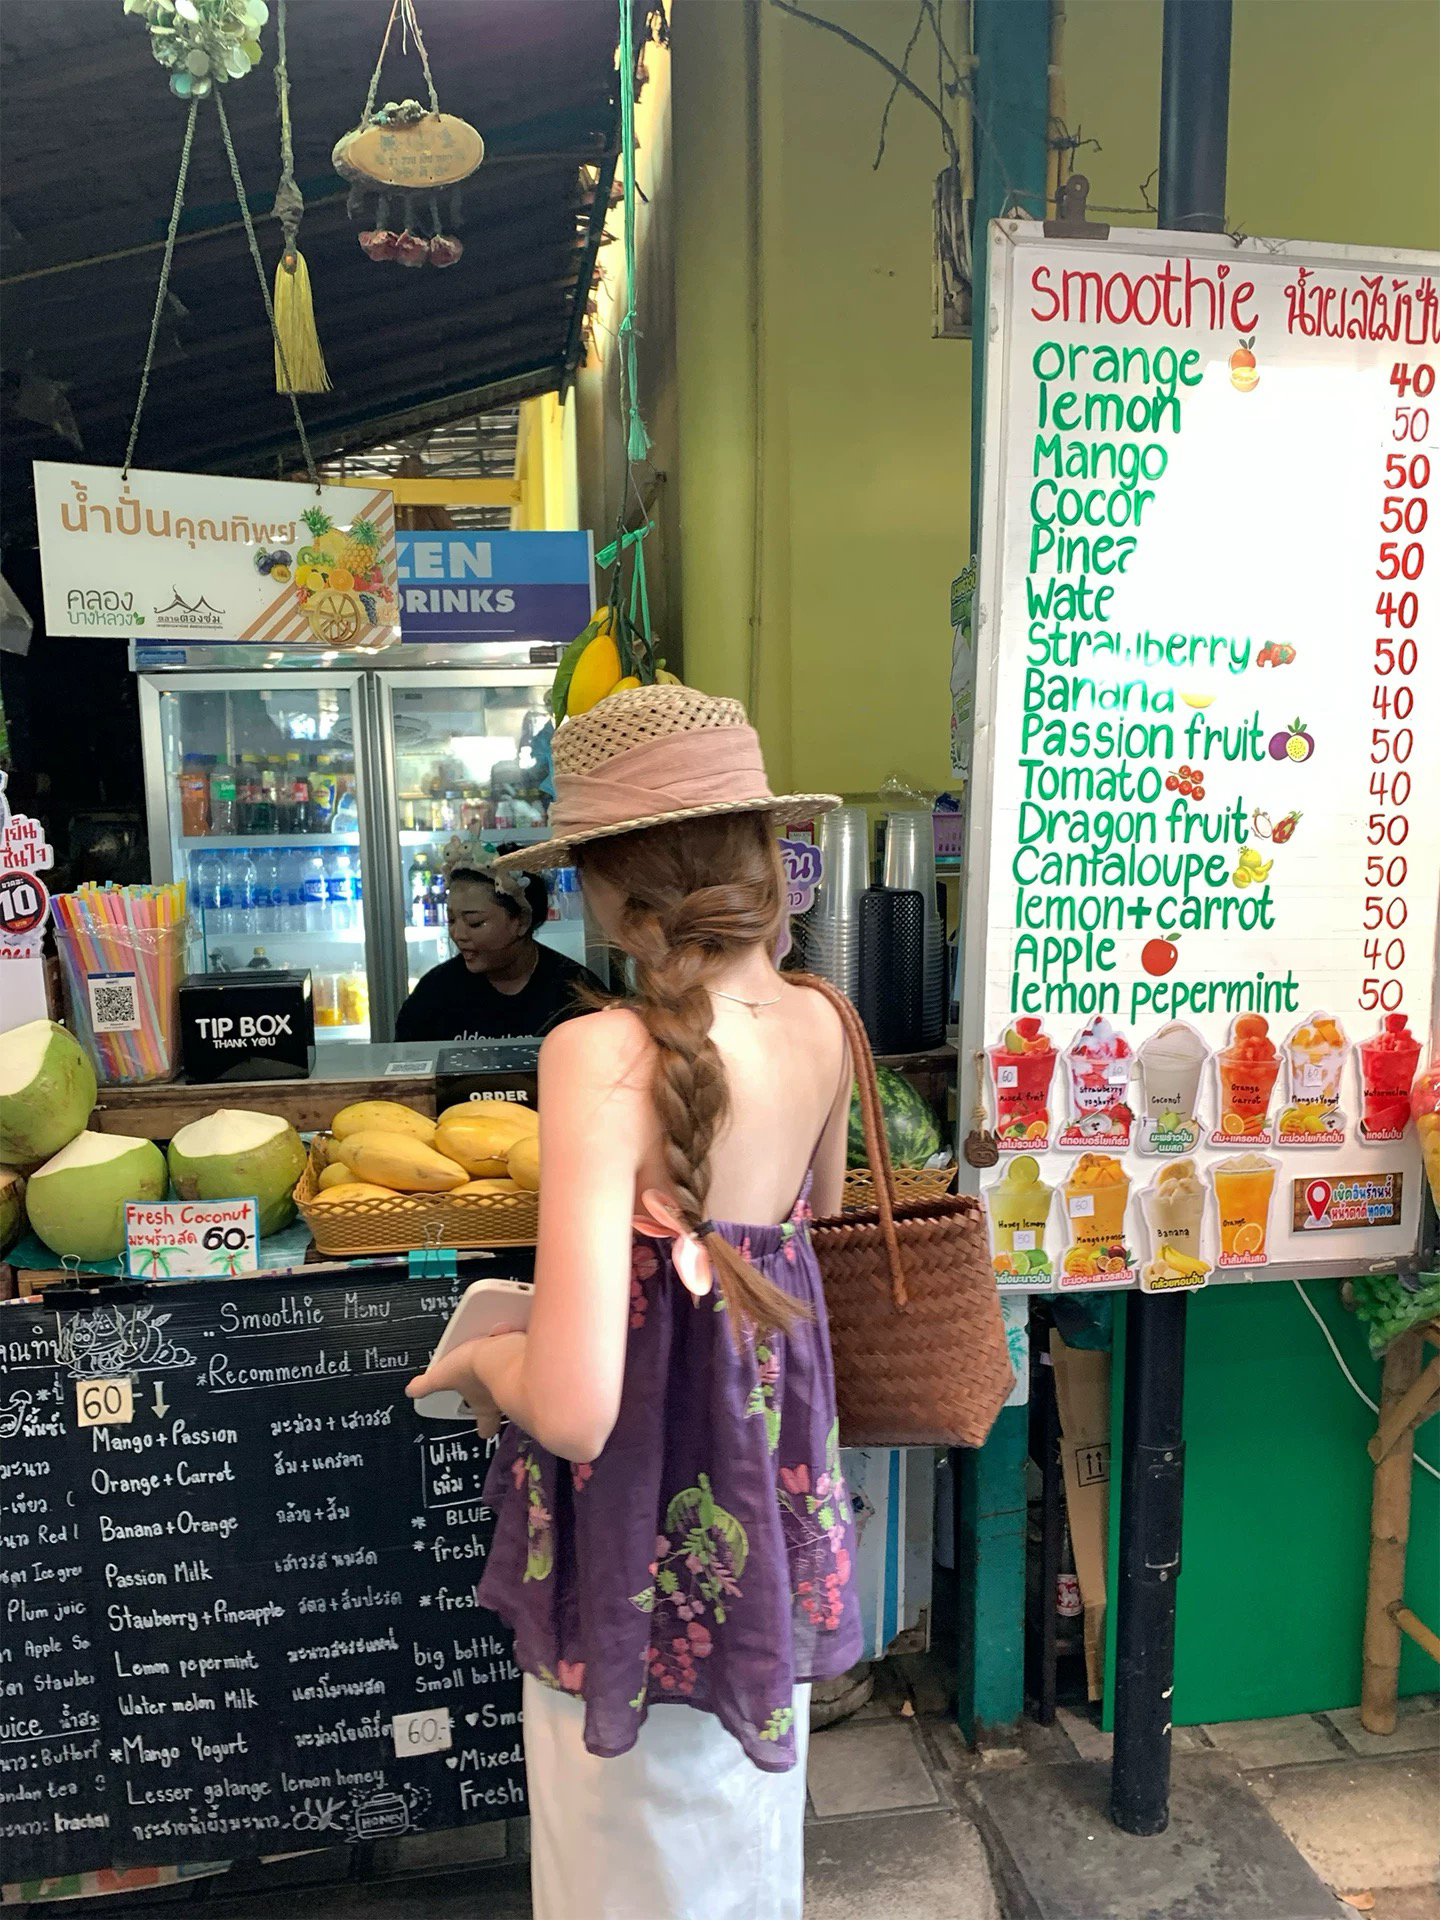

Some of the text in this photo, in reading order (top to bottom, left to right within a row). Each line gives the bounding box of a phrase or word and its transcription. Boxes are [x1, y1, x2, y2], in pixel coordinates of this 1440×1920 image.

[1389, 363, 1435, 397] 40
[1392, 407, 1429, 442] 50
[1033, 434, 1430, 490] Mango 50
[1380, 497, 1428, 534] 50
[1375, 542, 1424, 580] 50
[67, 589, 133, 611] คลอง
[399, 588, 516, 614] RINKS
[1375, 592, 1418, 629] 40
[67, 611, 133, 626] บางหลวง
[1375, 638, 1417, 675] 50
[1024, 668, 1414, 719] Banana 40
[1021, 710, 1413, 763] Passion fruit 50
[1019, 759, 1411, 806] Tomato 40
[1018, 796, 1409, 853] Dragon fruit 50
[1365, 855, 1407, 887] 50
[0, 884, 38, 921] 10
[1363, 897, 1407, 930] 50
[1014, 932, 1405, 984] Apple 40
[1010, 970, 1403, 1025] lemon pepermint 50
[195, 1014, 293, 1039] TIP BOX
[212, 1036, 276, 1049] THANK YOU
[1001, 1070, 1013, 1083] 60
[1231, 1083, 1260, 1093] Orange
[469, 1090, 529, 1101] ORDER
[126, 1203, 251, 1225] Fresh Coconut
[1157, 1229, 1190, 1238] Banana
[344, 1292, 391, 1319] Menu
[209, 1350, 352, 1387] Recommended
[365, 1346, 409, 1370] Menu
[83, 1385, 122, 1420] 60
[446, 1506, 492, 1526] BLUE
[38, 1525, 67, 1544] Red
[431, 1534, 486, 1563] fresh
[105, 1563, 167, 1589] Passion
[174, 1560, 213, 1583] Milk
[7, 1599, 49, 1622] Plum
[25, 1636, 62, 1658] Apple
[413, 1635, 505, 1670] big bottle
[415, 1660, 523, 1693] Small bottle
[225, 1688, 259, 1709] Milk
[0, 1716, 44, 1738] uice
[122, 1734, 180, 1768] Mango
[191, 1732, 248, 1763] Yogurt
[459, 1743, 525, 1772] Mixed
[47, 1781, 78, 1798] tea
[126, 1780, 193, 1805] Lesser
[281, 1773, 331, 1792] lemon
[461, 1778, 524, 1810] Fresh
[362, 1813, 404, 1829] HONEY
